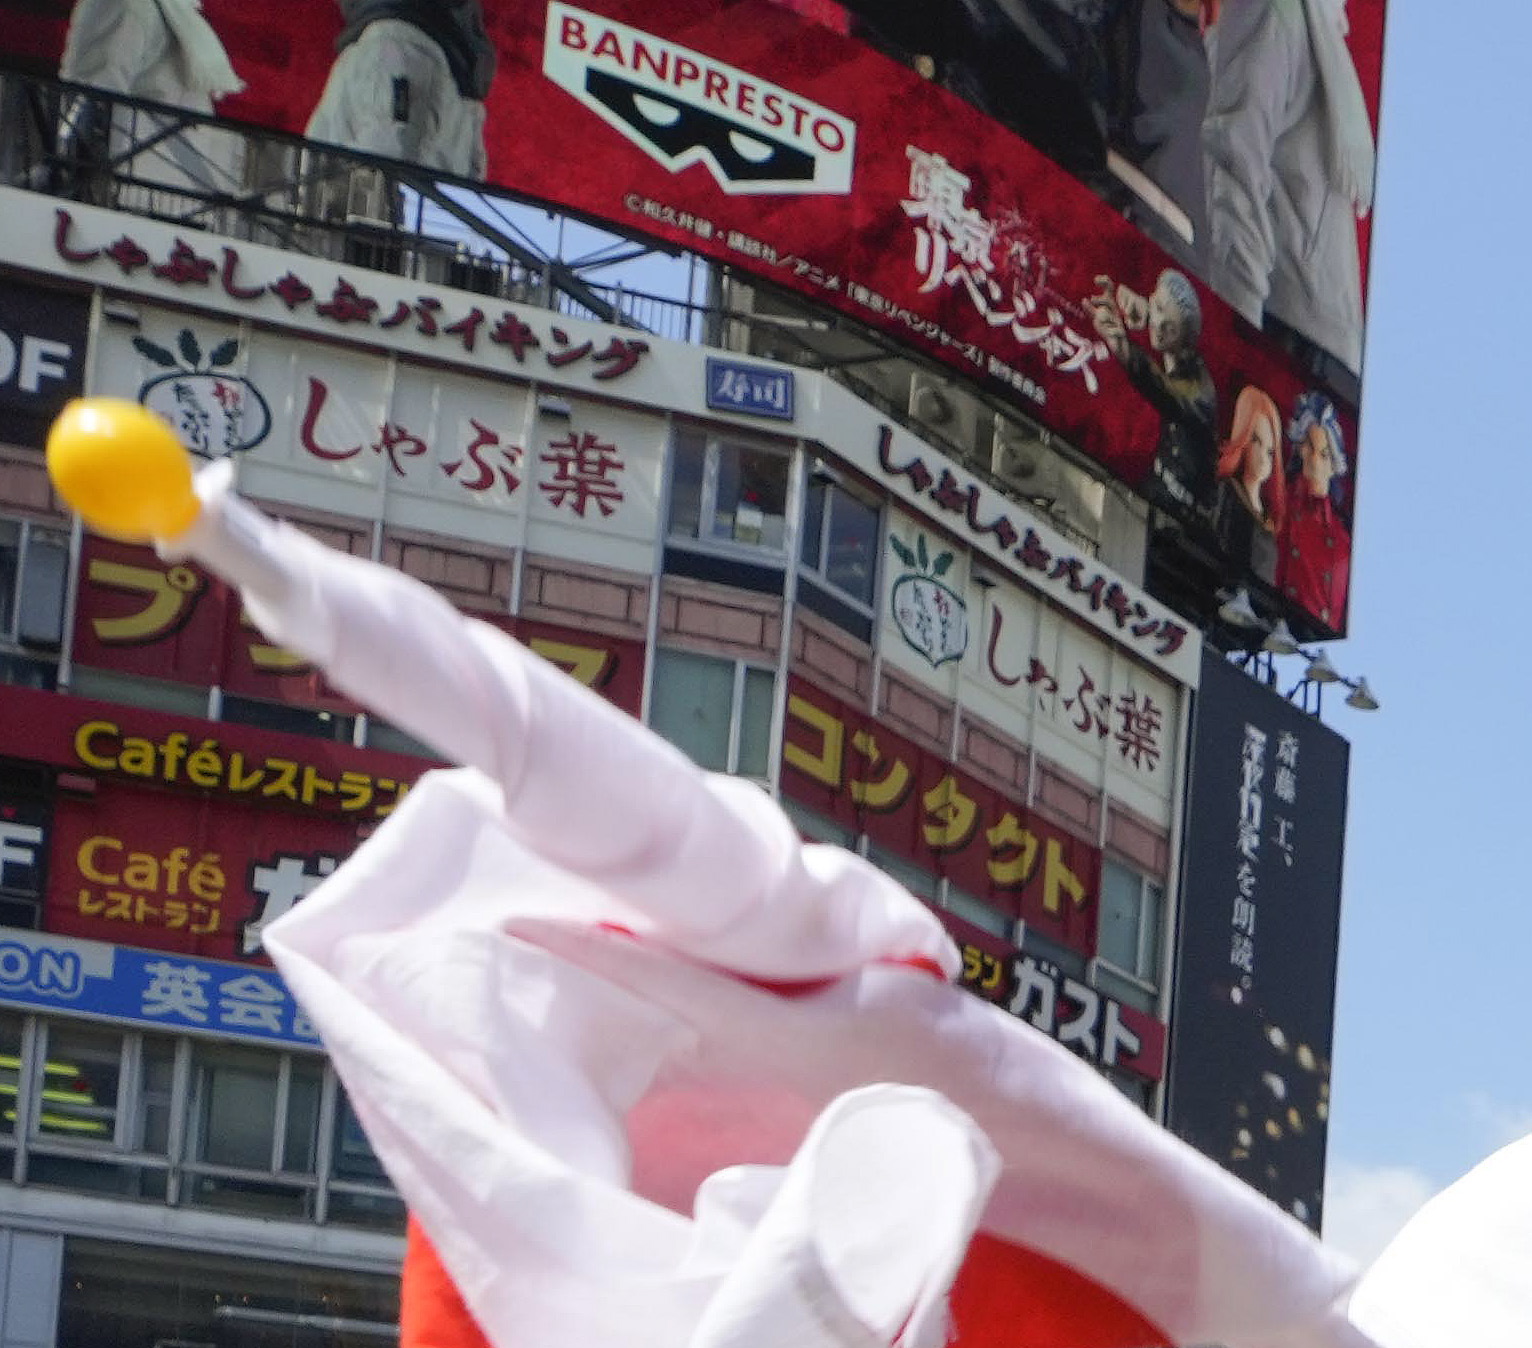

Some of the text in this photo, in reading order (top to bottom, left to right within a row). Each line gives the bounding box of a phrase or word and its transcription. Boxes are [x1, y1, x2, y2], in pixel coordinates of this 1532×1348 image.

[561, 16, 845, 152] BANPRESTO
[56, 208, 649, 380] しゃぶしゃぶバイキング
[302, 376, 625, 518] しゃぶ葉
[879, 424, 1187, 655] しゃぶしゃぶバイキング
[988, 603, 1162, 771] しゃぶ葉
[77, 836, 225, 900] Café
[783, 693, 1085, 909] コンタクト
[78, 890, 220, 933] レストラン
[141, 958, 320, 1036] 英会
[1009, 956, 1141, 1066] ガスト
